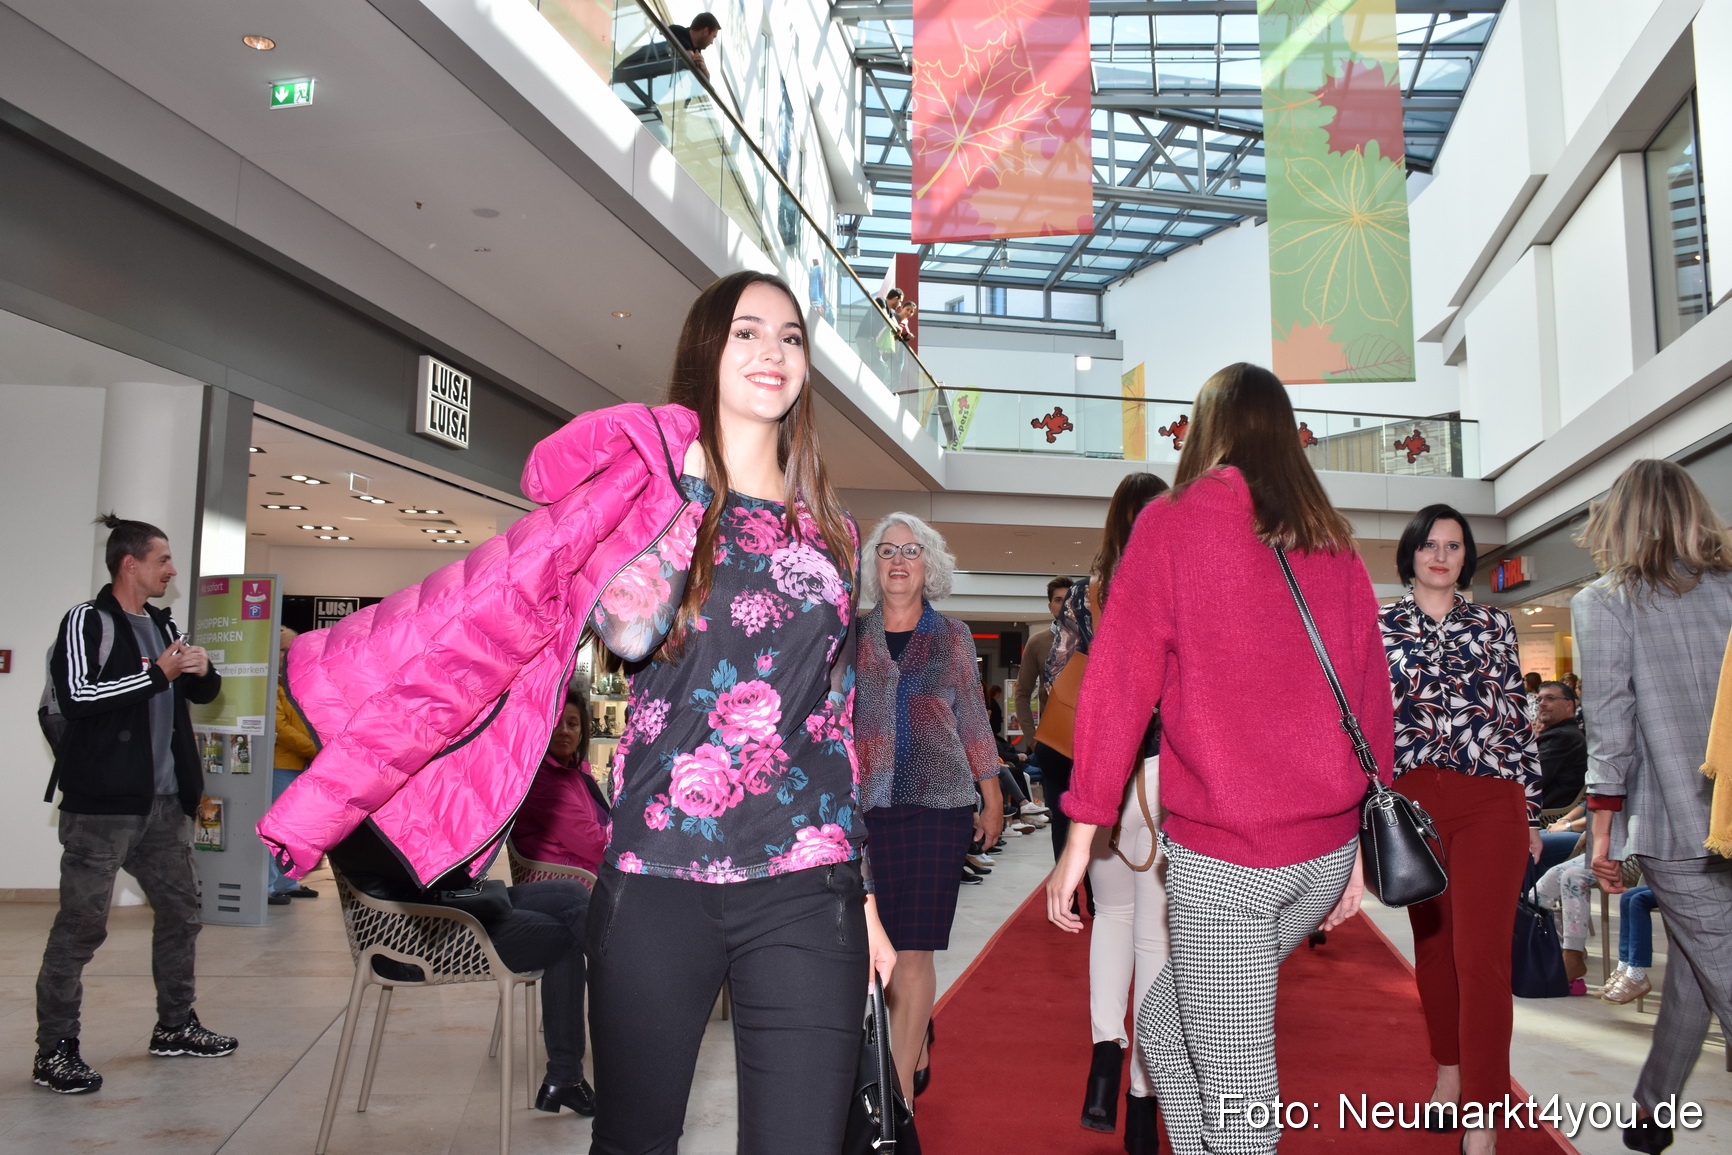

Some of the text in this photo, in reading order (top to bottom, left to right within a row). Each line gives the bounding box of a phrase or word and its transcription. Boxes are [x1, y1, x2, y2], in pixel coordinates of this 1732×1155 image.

[432, 363, 468, 407] LUISA
[430, 400, 466, 442] LUISA
[207, 582, 223, 592] sofort
[318, 601, 354, 615] LUISA
[197, 616, 229, 630] SHOPPEN
[196, 631, 243, 643] FREIPARKEN
